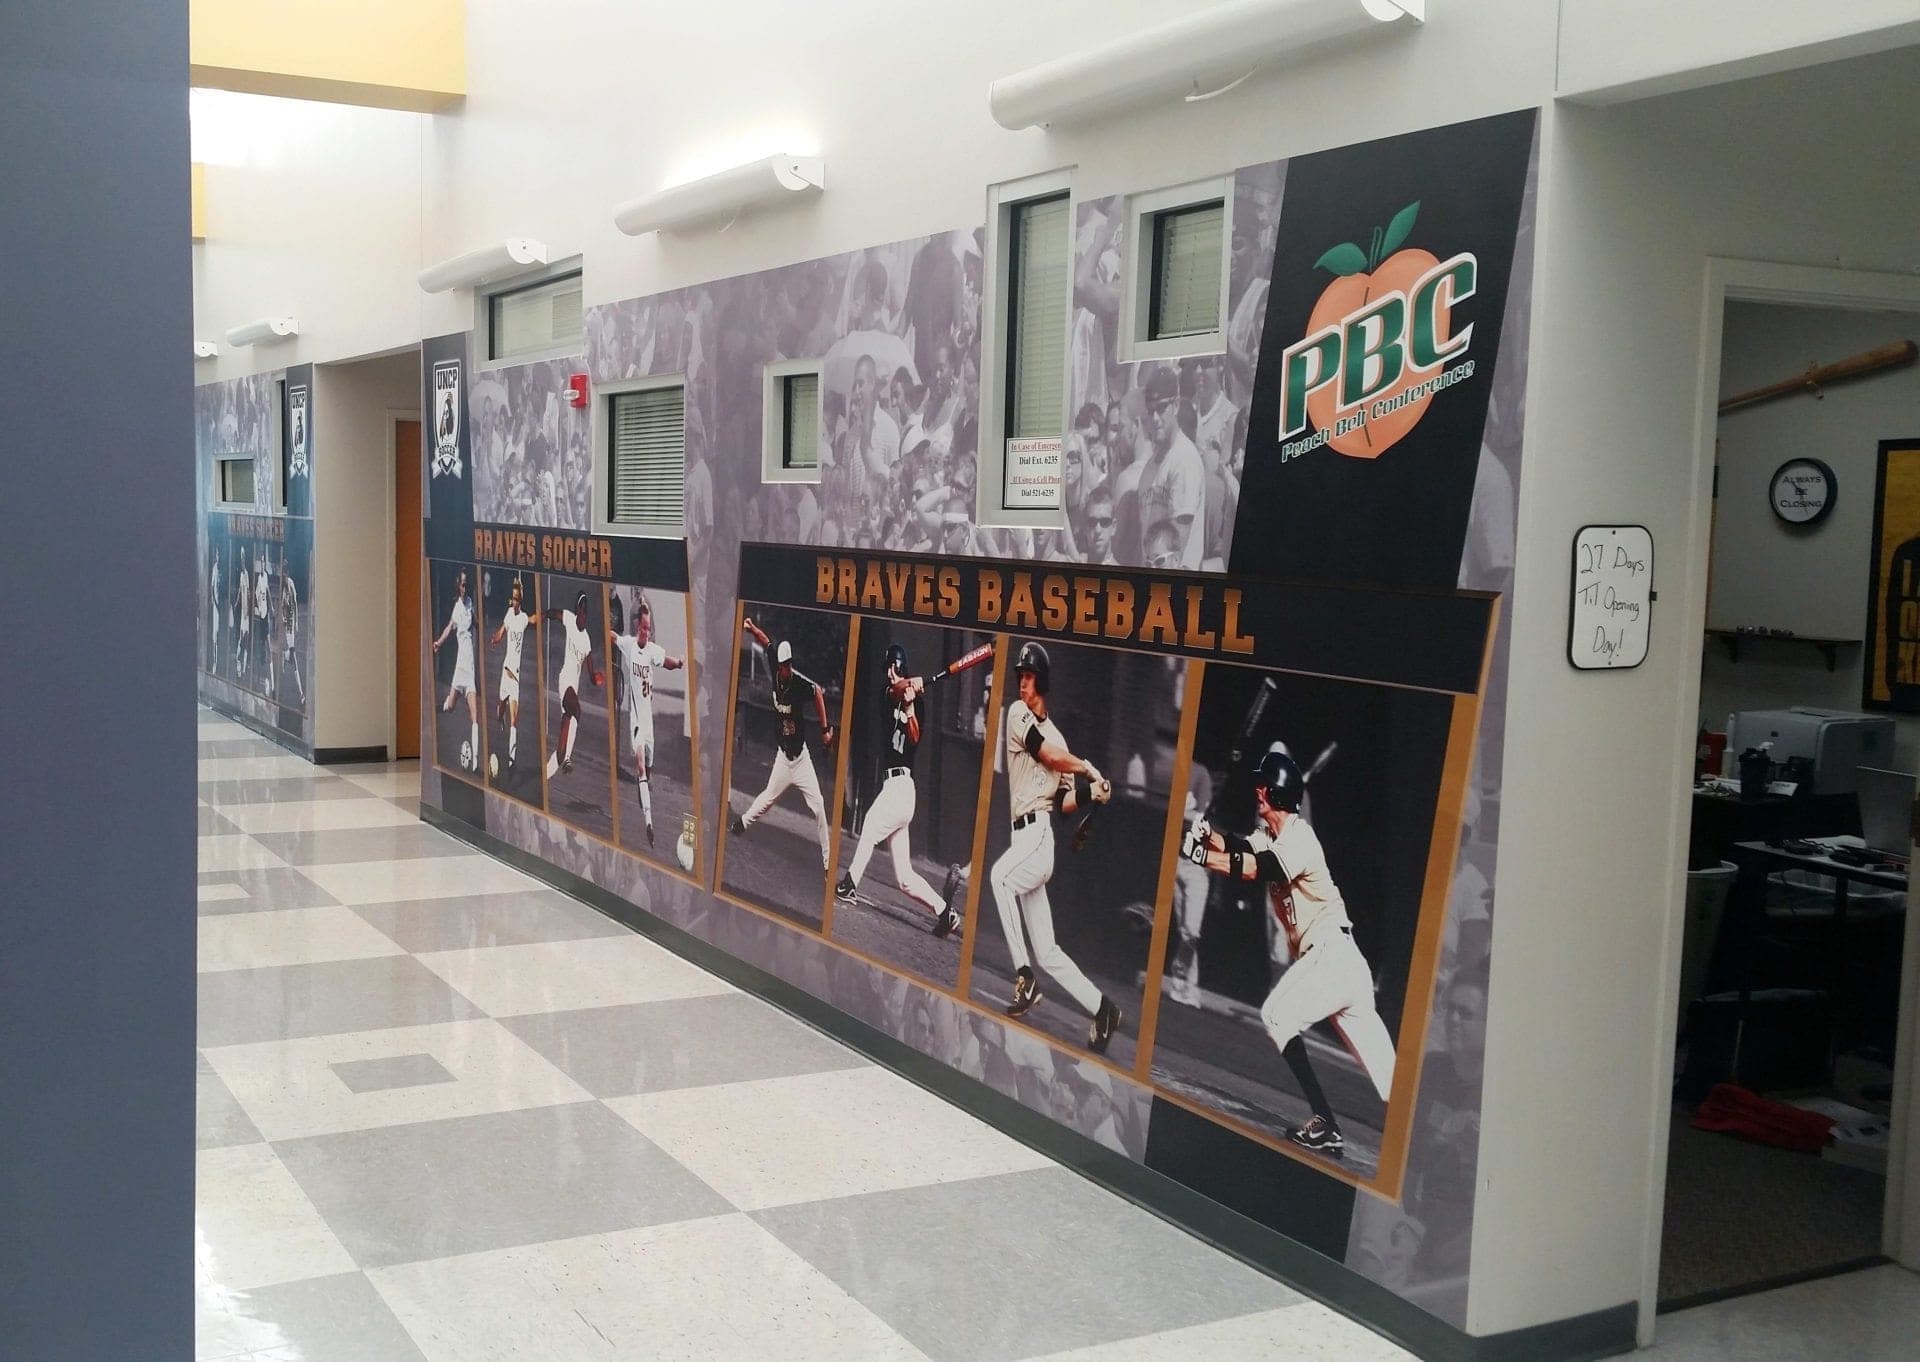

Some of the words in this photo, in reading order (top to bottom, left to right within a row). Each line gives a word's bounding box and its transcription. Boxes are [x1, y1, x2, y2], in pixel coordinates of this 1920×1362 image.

[1278, 252, 1478, 442] PBC
[437, 368, 458, 390] UNCP
[1281, 427, 1331, 463] Peach
[1335, 409, 1367, 437] Belt
[1372, 359, 1475, 420] Conference
[1019, 456, 1031, 465] Dial
[1032, 456, 1043, 465] Ext.
[1044, 455, 1058, 465] 6235
[1021, 488, 1032, 497] Dial
[474, 528, 536, 567] BRAVES
[541, 534, 613, 578] SOCCER
[1580, 543, 1604, 574] 27
[1613, 546, 1645, 577] Days
[815, 556, 961, 619] BRAVES
[977, 569, 1255, 655] BASEBALL
[1604, 586, 1640, 621] Opening
[1592, 625, 1624, 660] Day!
